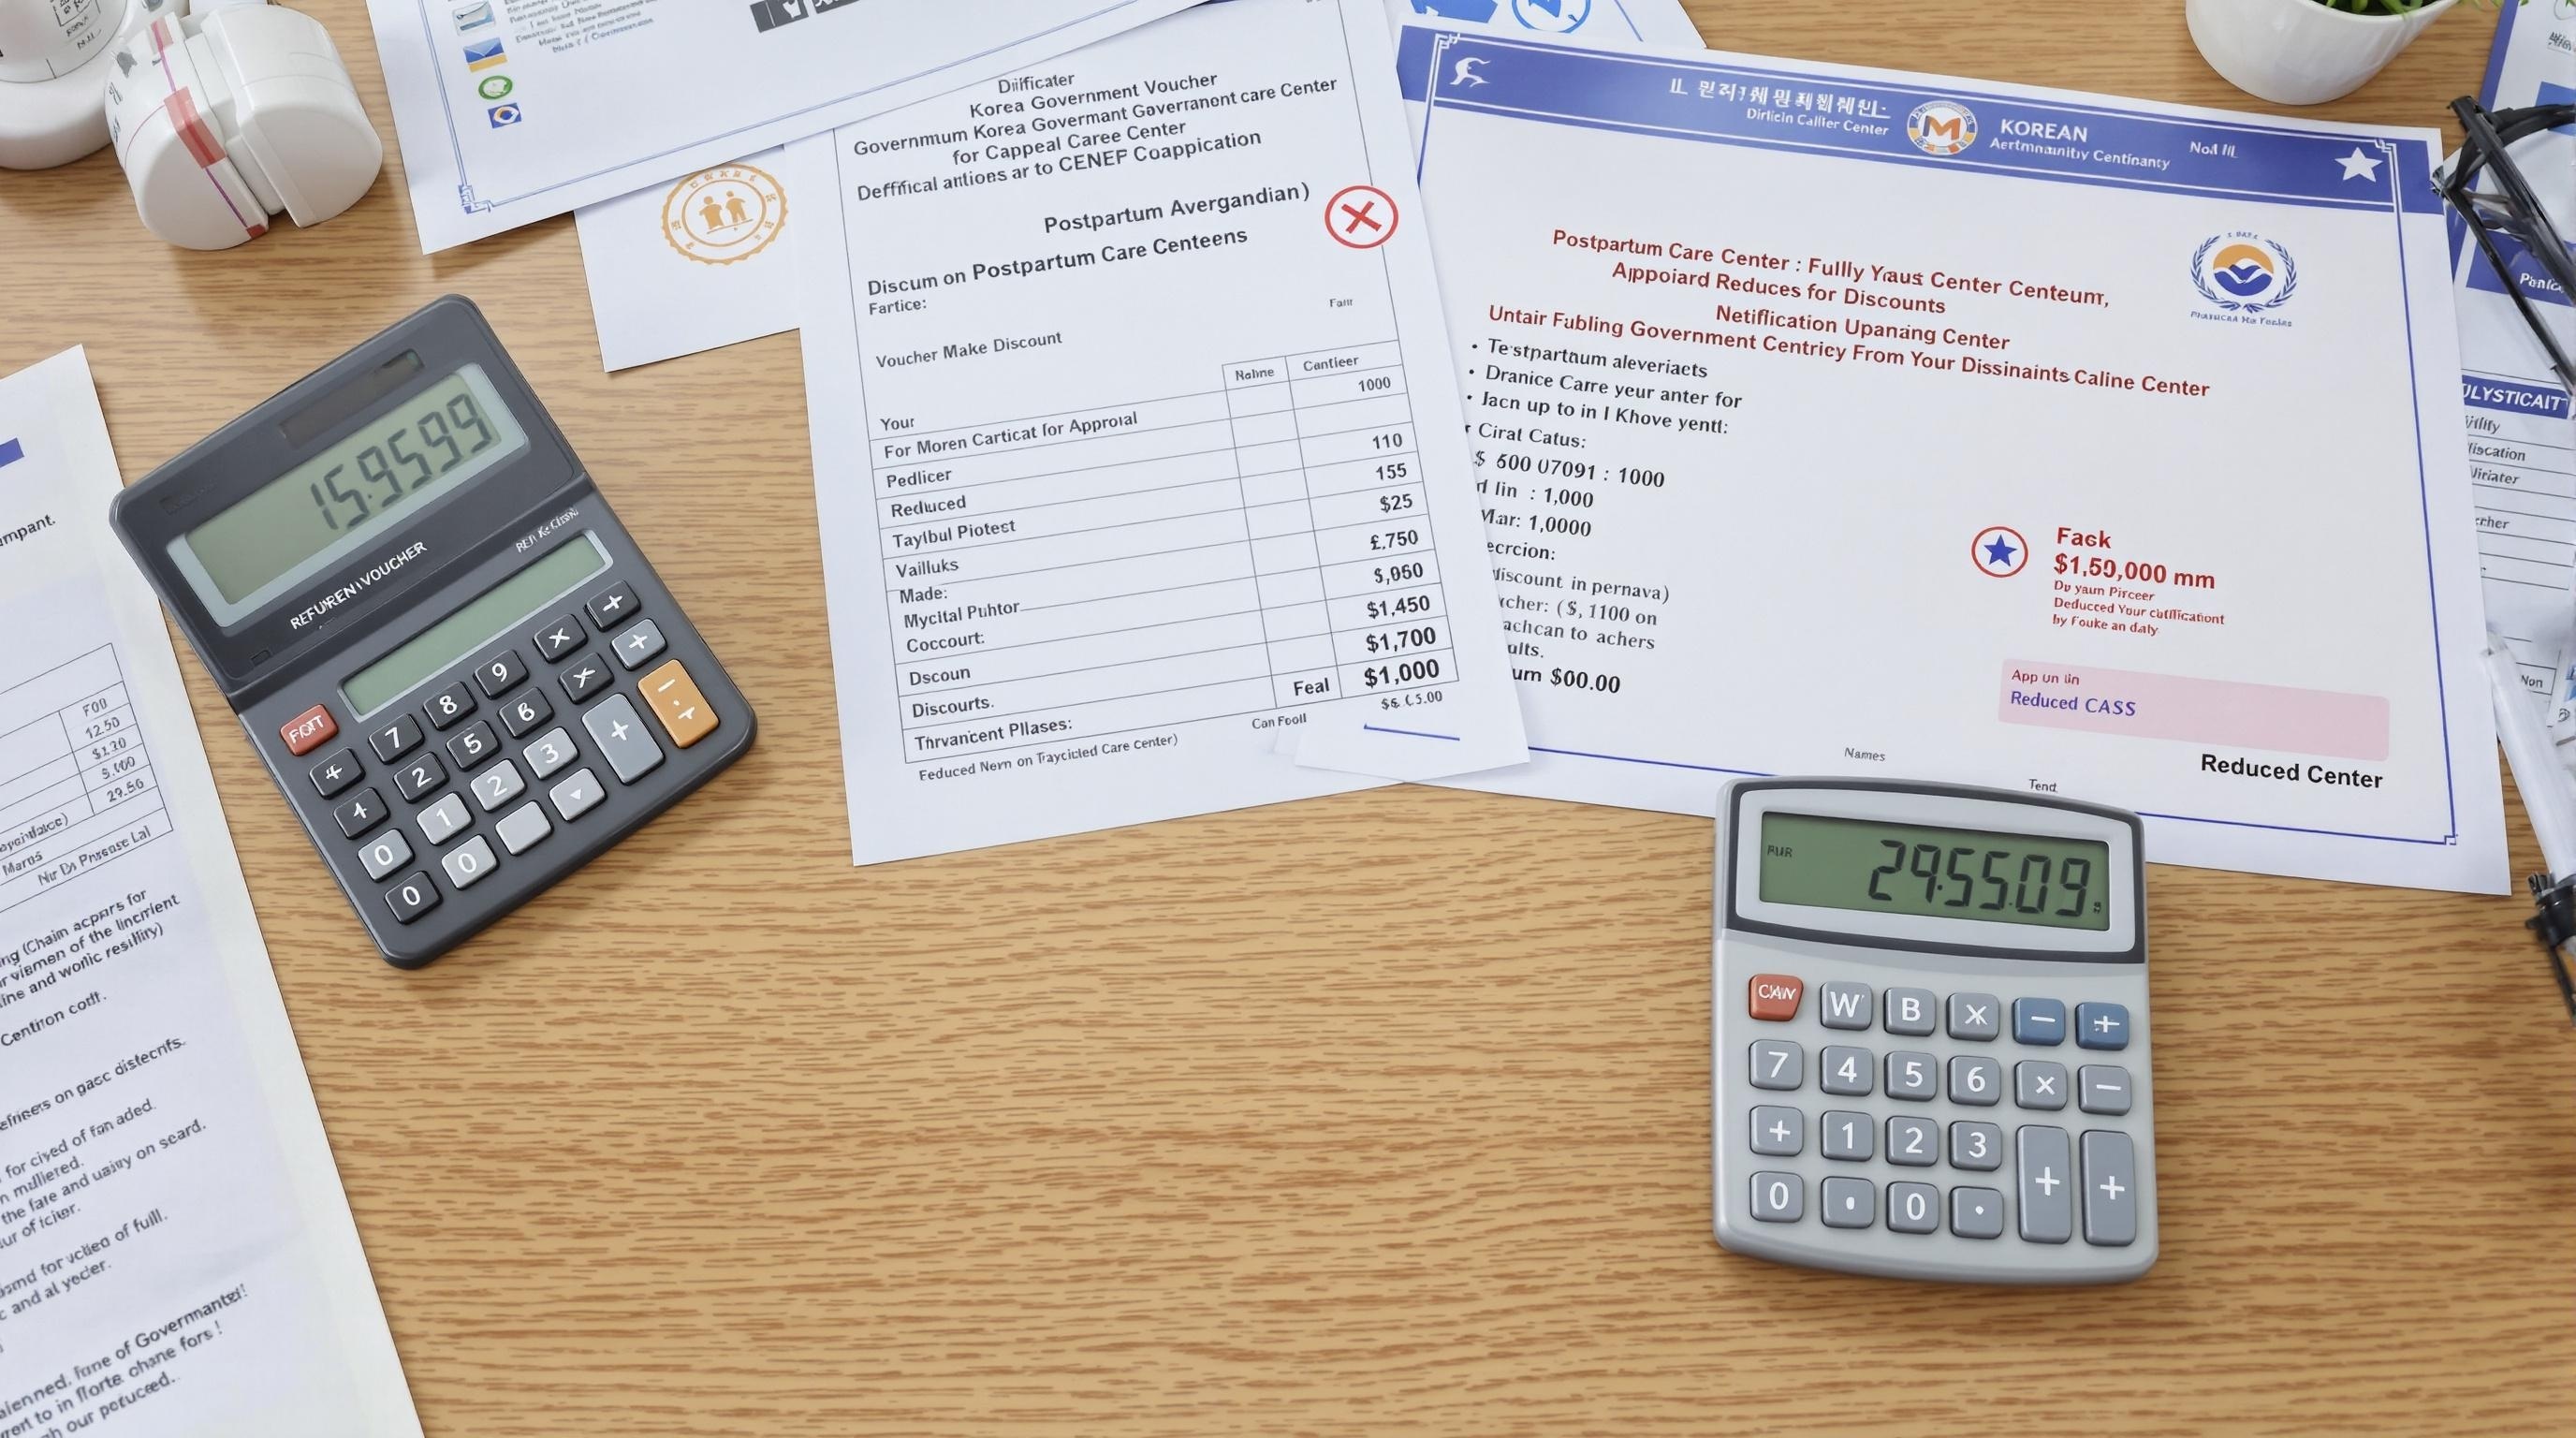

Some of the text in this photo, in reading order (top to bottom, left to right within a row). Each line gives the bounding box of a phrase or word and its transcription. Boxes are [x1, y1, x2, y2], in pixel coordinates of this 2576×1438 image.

[971, 75, 1218, 118] Korea Government Voucher
[974, 124, 1026, 139] Korea
[1240, 89, 1276, 103] care
[1281, 80, 1337, 96] Center
[1844, 120, 1888, 135] Center
[2001, 119, 2087, 142] KOREAN
[953, 150, 979, 165] for
[1127, 123, 1186, 139] Center
[1034, 163, 1053, 175] to
[1045, 207, 1163, 233] Postpartum
[944, 271, 966, 285] on
[973, 253, 1095, 280] Postpartum
[1102, 245, 1147, 262] Care
[1554, 229, 1662, 257] Postpartum
[1669, 242, 1713, 261] Care
[1721, 249, 1790, 270] Center
[1931, 271, 2002, 294] Center
[1717, 273, 1945, 314] Reduces for Discounts
[1943, 329, 2010, 349] Center
[876, 332, 1062, 367] Voucher Make Discount
[1631, 321, 1756, 349] Government
[1853, 345, 1904, 365] From
[1910, 351, 1955, 370] Your
[2142, 376, 2210, 396] Center
[1358, 376, 1391, 391] 1000
[1486, 364, 1553, 388] Dranice
[1661, 390, 1709, 404] anter
[1716, 391, 1742, 408] for
[1528, 401, 1550, 416] up
[1558, 403, 1574, 417] to
[1581, 404, 1596, 418] in
[880, 418, 914, 431] Your
[1373, 433, 1402, 449] 110
[311, 393, 492, 530] 15.9599
[885, 446, 911, 459] For
[1376, 462, 1407, 480] 155
[1619, 467, 1664, 487] 1000
[1380, 493, 1412, 513] $25
[1544, 488, 1593, 507] 1,000
[1530, 515, 1591, 536] 1,0000
[1572, 577, 1587, 591] in
[2174, 573, 2215, 589] mm
[900, 585, 948, 604] Made:
[1368, 595, 1430, 619] $1,450
[1635, 613, 1657, 625] on
[1366, 627, 1436, 653] $1,700
[1572, 627, 1588, 640] to
[492, 663, 506, 682] 9
[910, 668, 971, 685] Dscoun
[1365, 659, 1439, 689] $1,000
[1550, 668, 1620, 694] $00.00
[1294, 678, 1329, 696] Feal
[440, 696, 457, 714] 8
[518, 703, 534, 721] 6
[913, 697, 994, 718] Discourts.
[2011, 691, 2136, 716] Reduced CASS
[1252, 718, 1275, 729] Can
[385, 727, 399, 748] 7
[464, 733, 481, 754] 5
[541, 744, 558, 763] 3
[1017, 743, 1130, 767] on Care
[412, 768, 432, 787] 2
[2202, 754, 2383, 788] Reduced Center
[488, 776, 506, 796] 2
[437, 809, 450, 826] 1
[375, 845, 393, 865] 0
[459, 854, 476, 873] 0
[126, 890, 146, 905] for
[402, 887, 420, 905] 0
[1902, 998, 1920, 1020] B
[1769, 1051, 1788, 1078] 7
[1838, 1057, 1856, 1082] 4
[1907, 1062, 1922, 1087] 5
[1968, 1067, 1984, 1092] 6
[1842, 1123, 1852, 1149] 1
[1906, 1127, 1923, 1153] 2
[1969, 1132, 1985, 1157] 3
[6, 1162, 26, 1178] for
[1770, 1182, 1788, 1210] 0
[1907, 1193, 1925, 1220] 0
[40, 1258, 64, 1275] for
[35, 1410, 52, 1424] to
